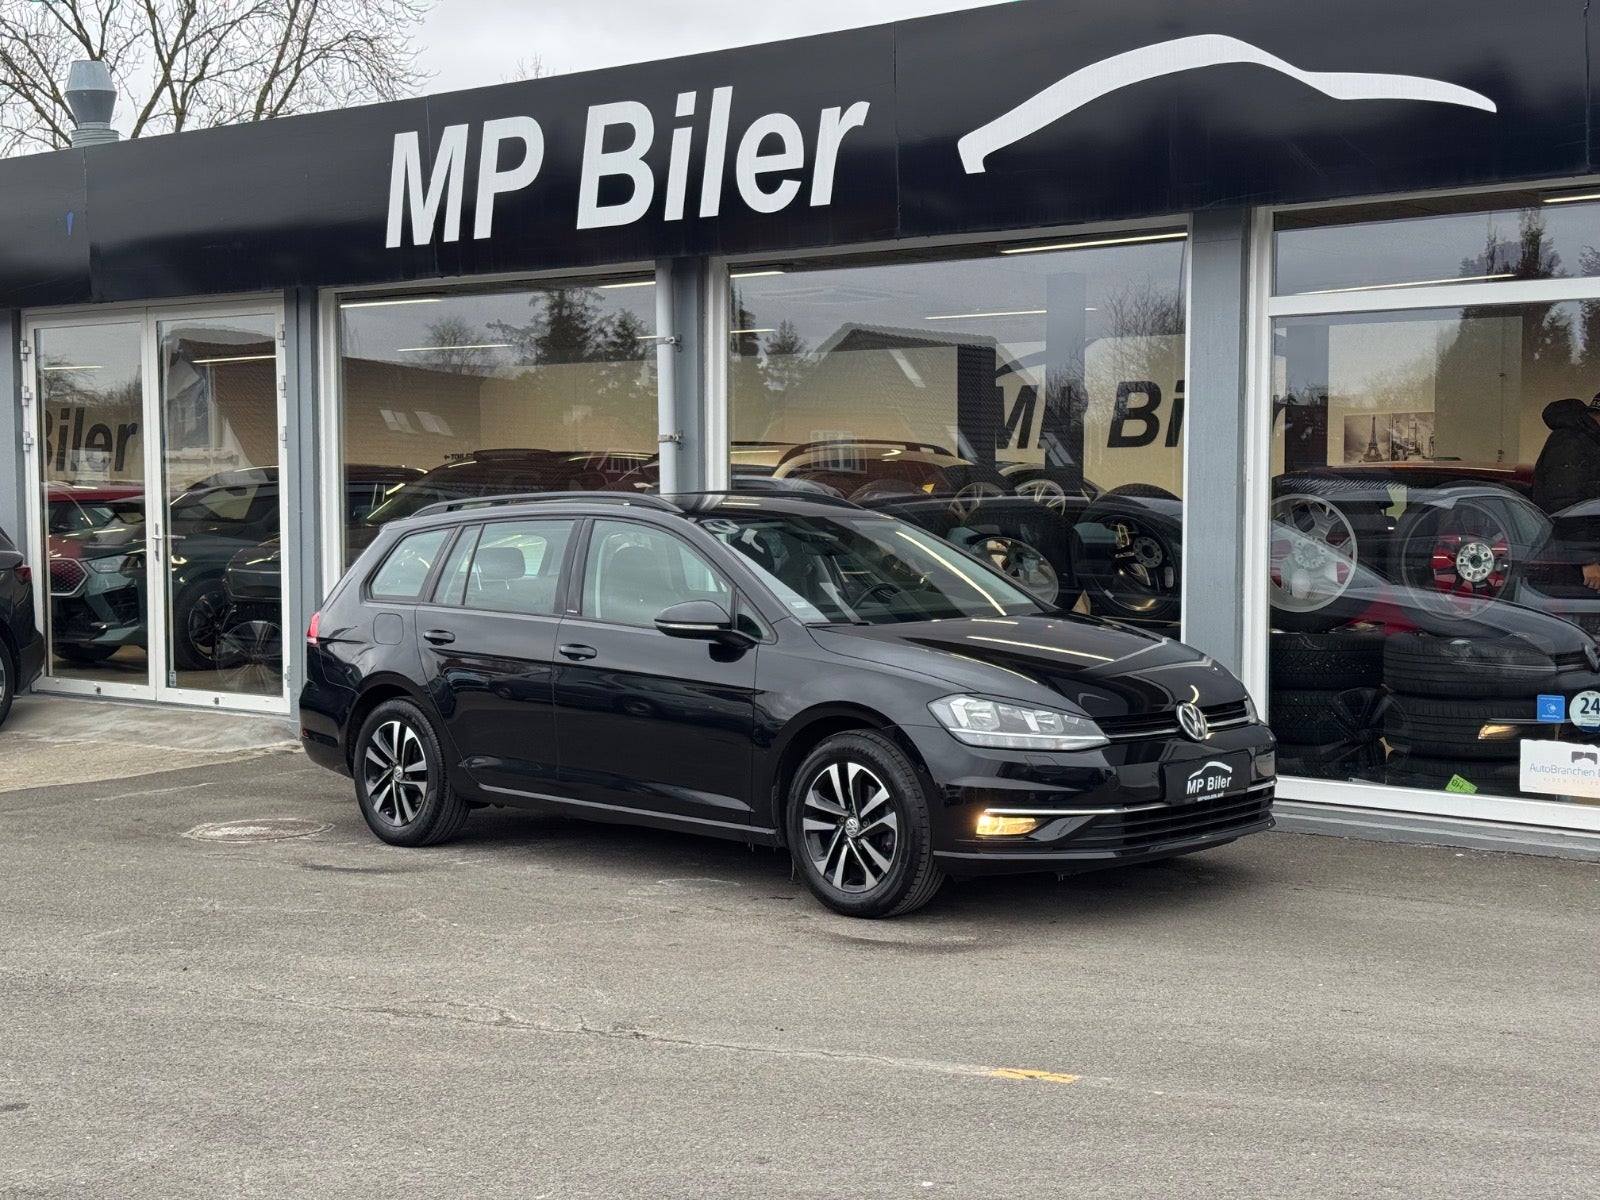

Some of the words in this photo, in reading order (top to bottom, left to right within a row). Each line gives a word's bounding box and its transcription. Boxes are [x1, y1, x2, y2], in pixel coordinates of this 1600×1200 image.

[385, 115, 545, 249] MP
[576, 85, 870, 230] Biler
[1529, 763, 1595, 777] AutoBranchen
[1186, 779, 1205, 795] MP
[1207, 775, 1232, 791] Biler
